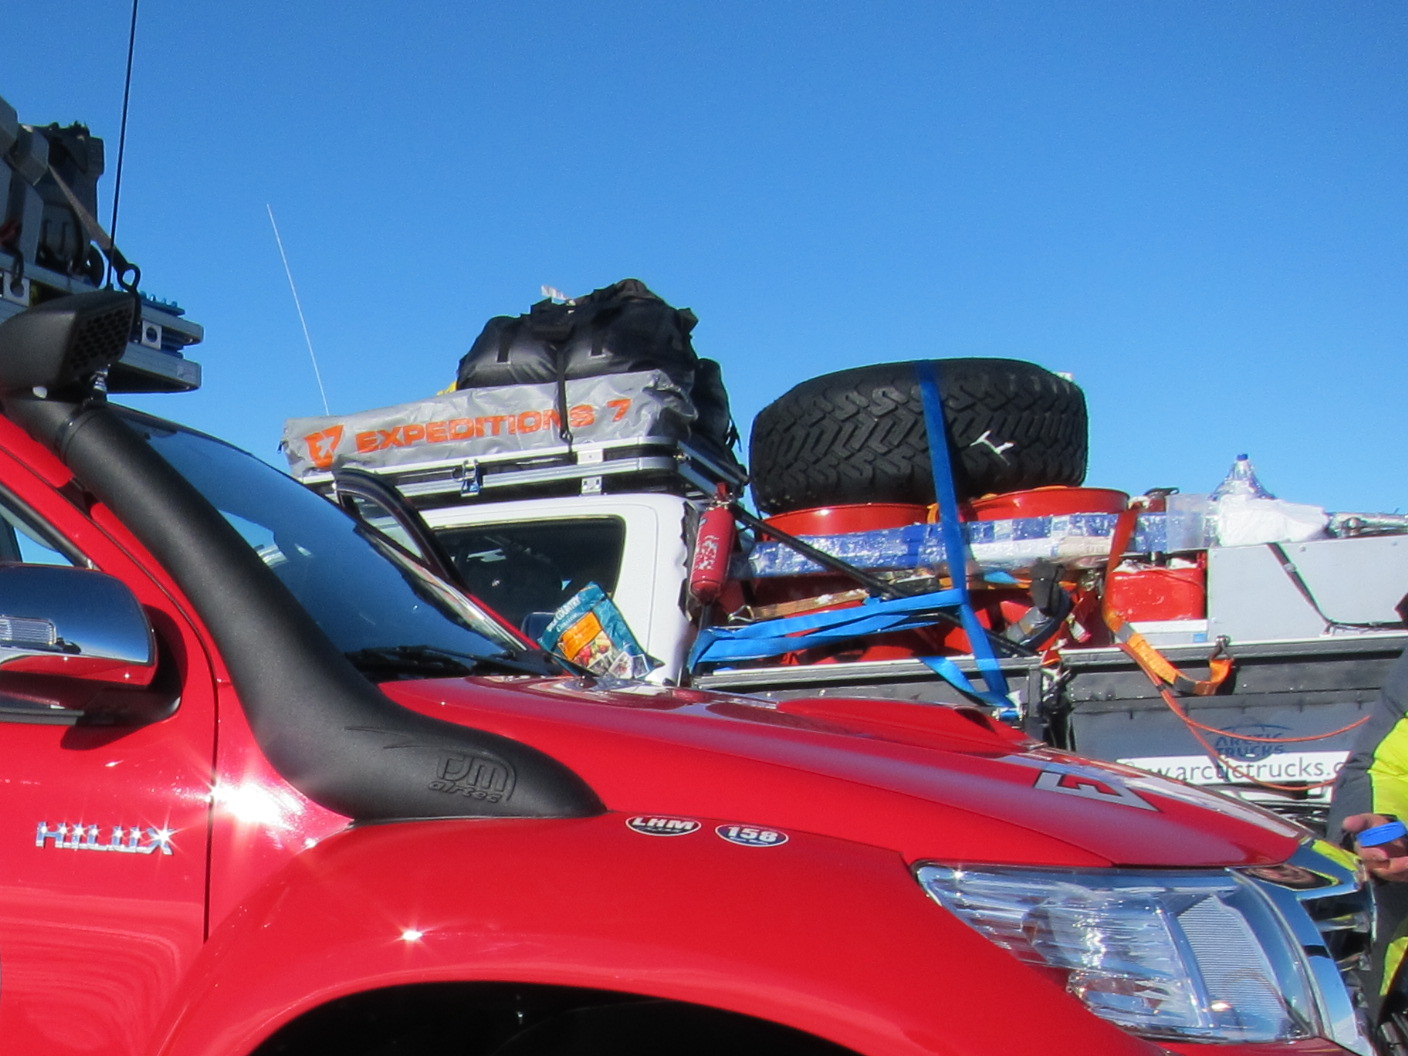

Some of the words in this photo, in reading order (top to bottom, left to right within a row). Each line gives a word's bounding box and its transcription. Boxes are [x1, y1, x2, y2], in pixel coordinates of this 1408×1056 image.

[354, 404, 597, 454] EXPEDITIONS
[606, 398, 632, 422] 7
[631, 816, 695, 831] LHM
[728, 826, 779, 843] 158
[35, 821, 174, 855] HILUX
